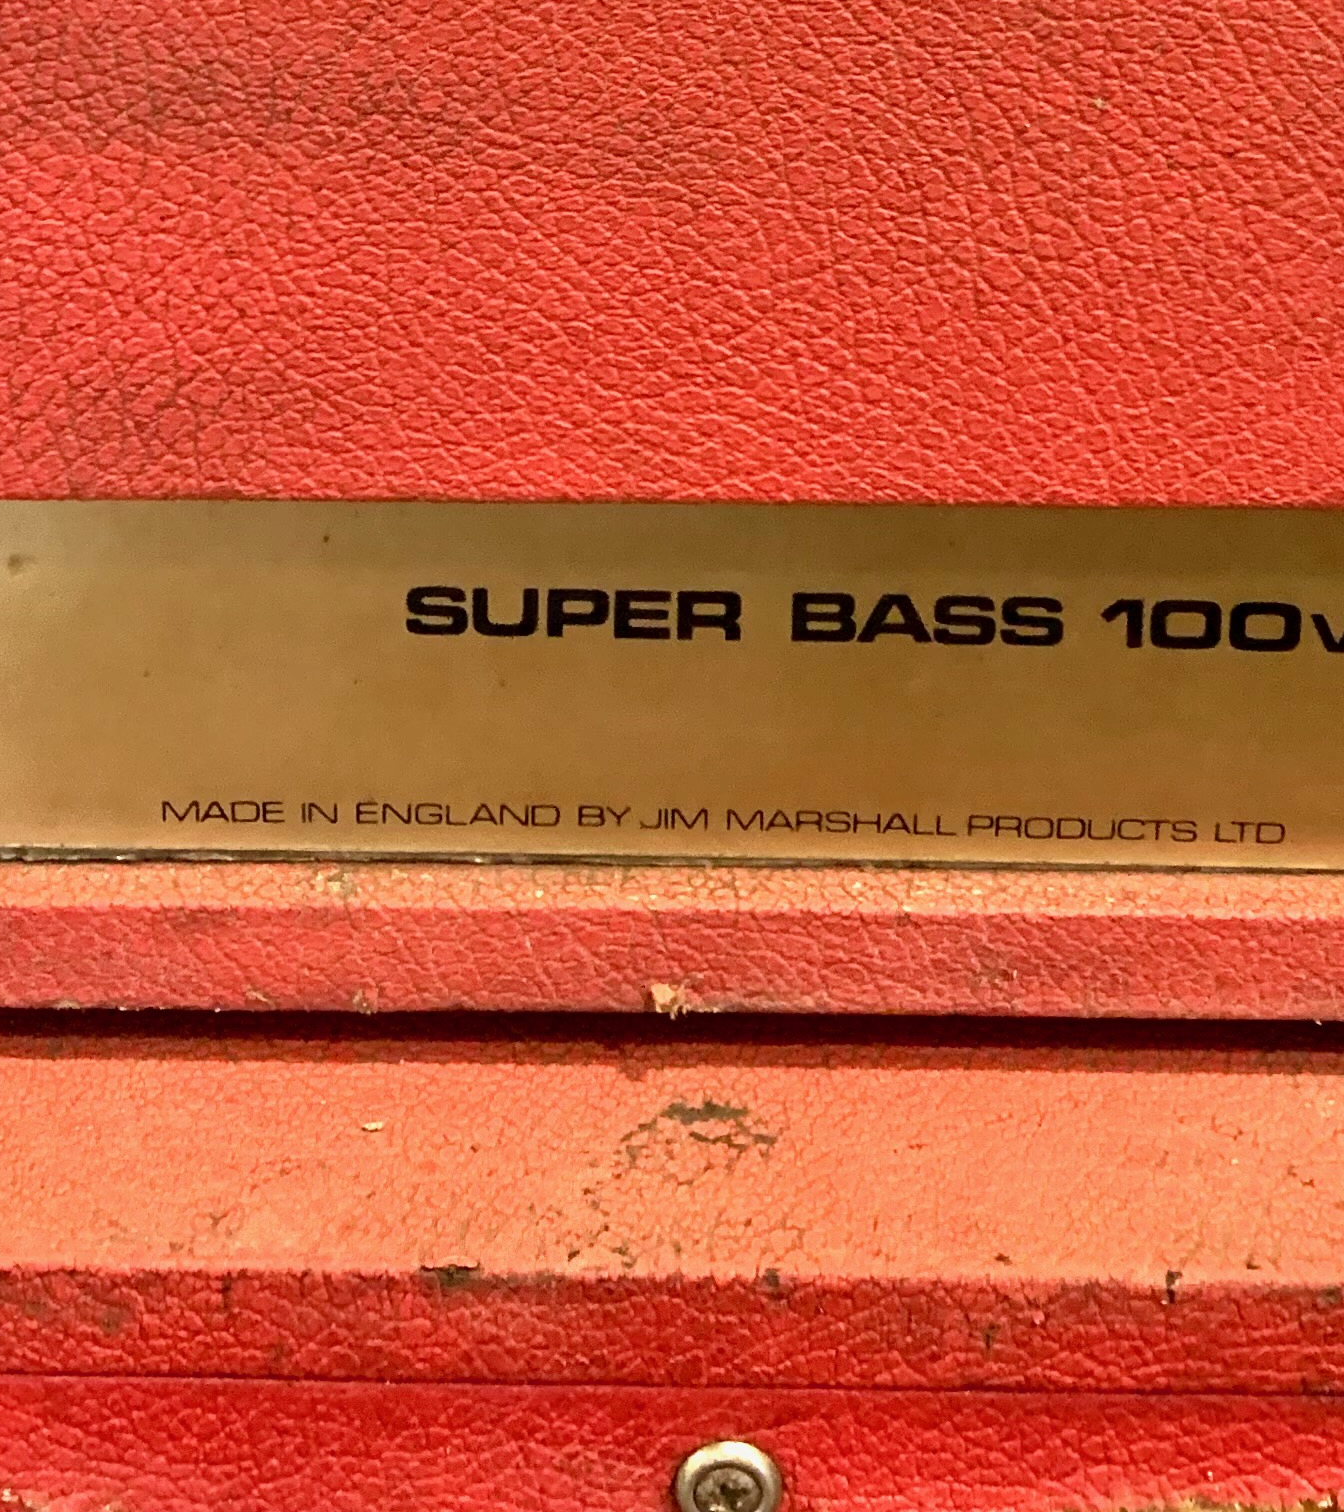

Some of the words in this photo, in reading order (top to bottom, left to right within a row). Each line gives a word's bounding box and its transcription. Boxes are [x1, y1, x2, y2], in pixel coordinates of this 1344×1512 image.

[404, 584, 743, 643] SUPER
[789, 591, 1066, 648] BASS
[161, 799, 286, 825] MADE
[299, 801, 339, 825] IN
[355, 801, 562, 829] ENGLAND
[576, 804, 632, 829] BY
[639, 806, 709, 832] JIM
[725, 807, 958, 838] MARSHALL
[965, 813, 1199, 844] PRODUCTS
[1212, 820, 1288, 846] LTD
